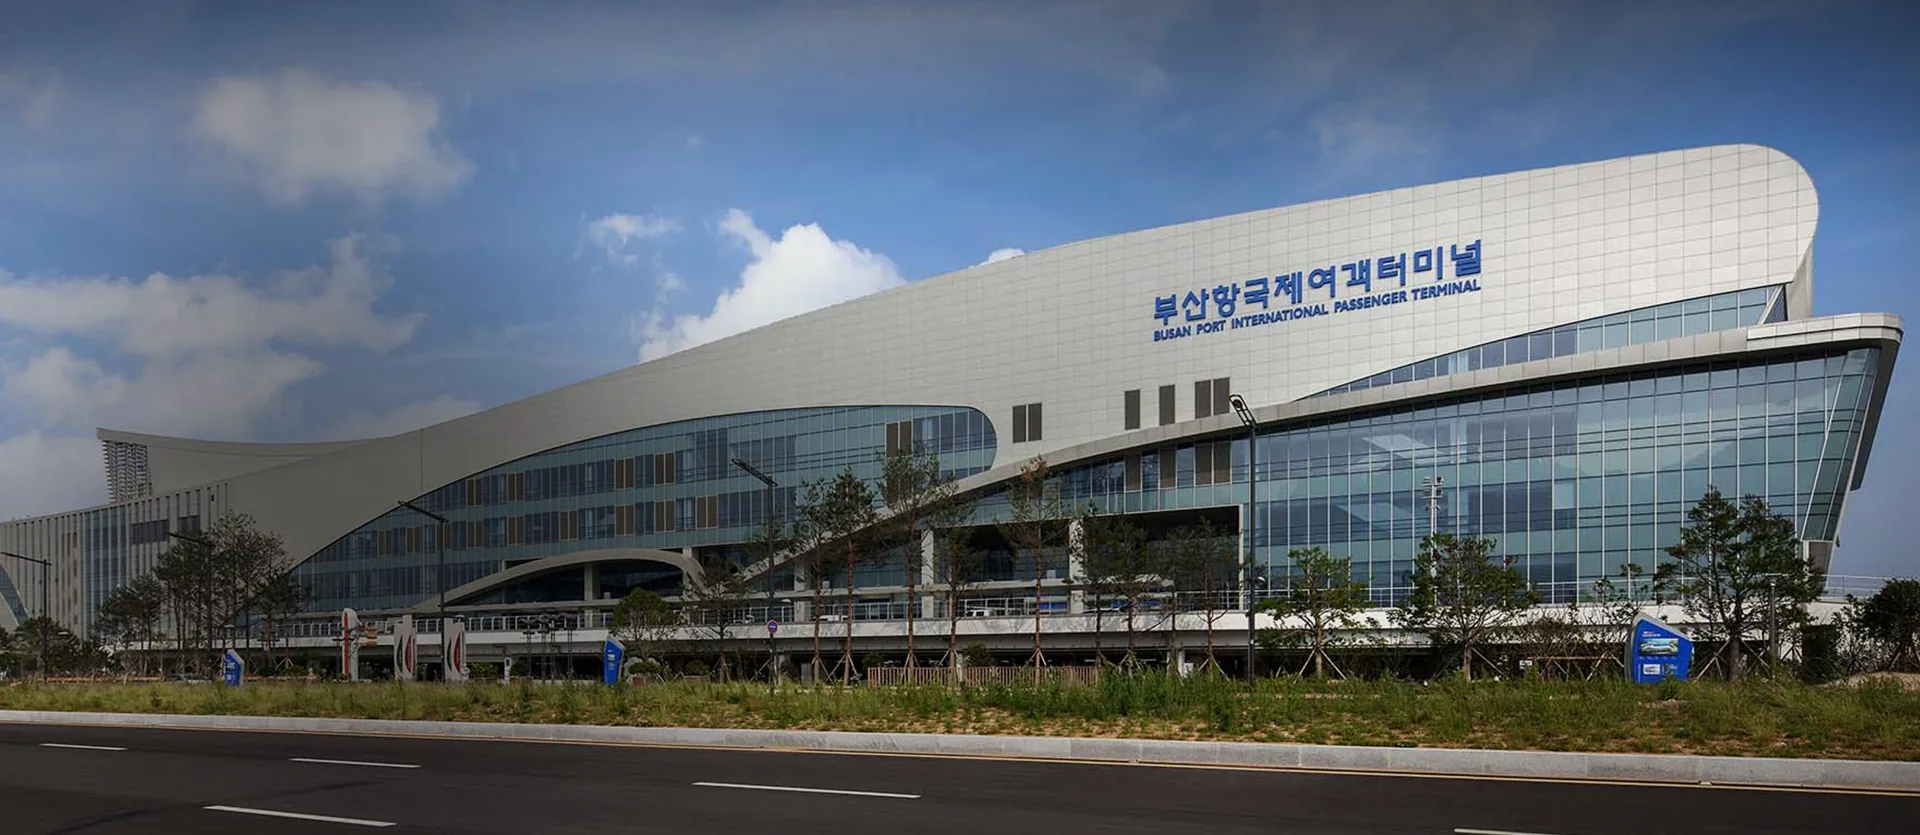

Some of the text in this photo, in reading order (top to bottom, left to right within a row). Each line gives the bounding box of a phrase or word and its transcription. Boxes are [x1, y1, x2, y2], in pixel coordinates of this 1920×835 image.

[1153, 239, 1482, 325] 부산항국제여객터미널
[1153, 278, 1482, 342] BUSAN PORT INTERNATIONAL PASSENGER TERMINAL
